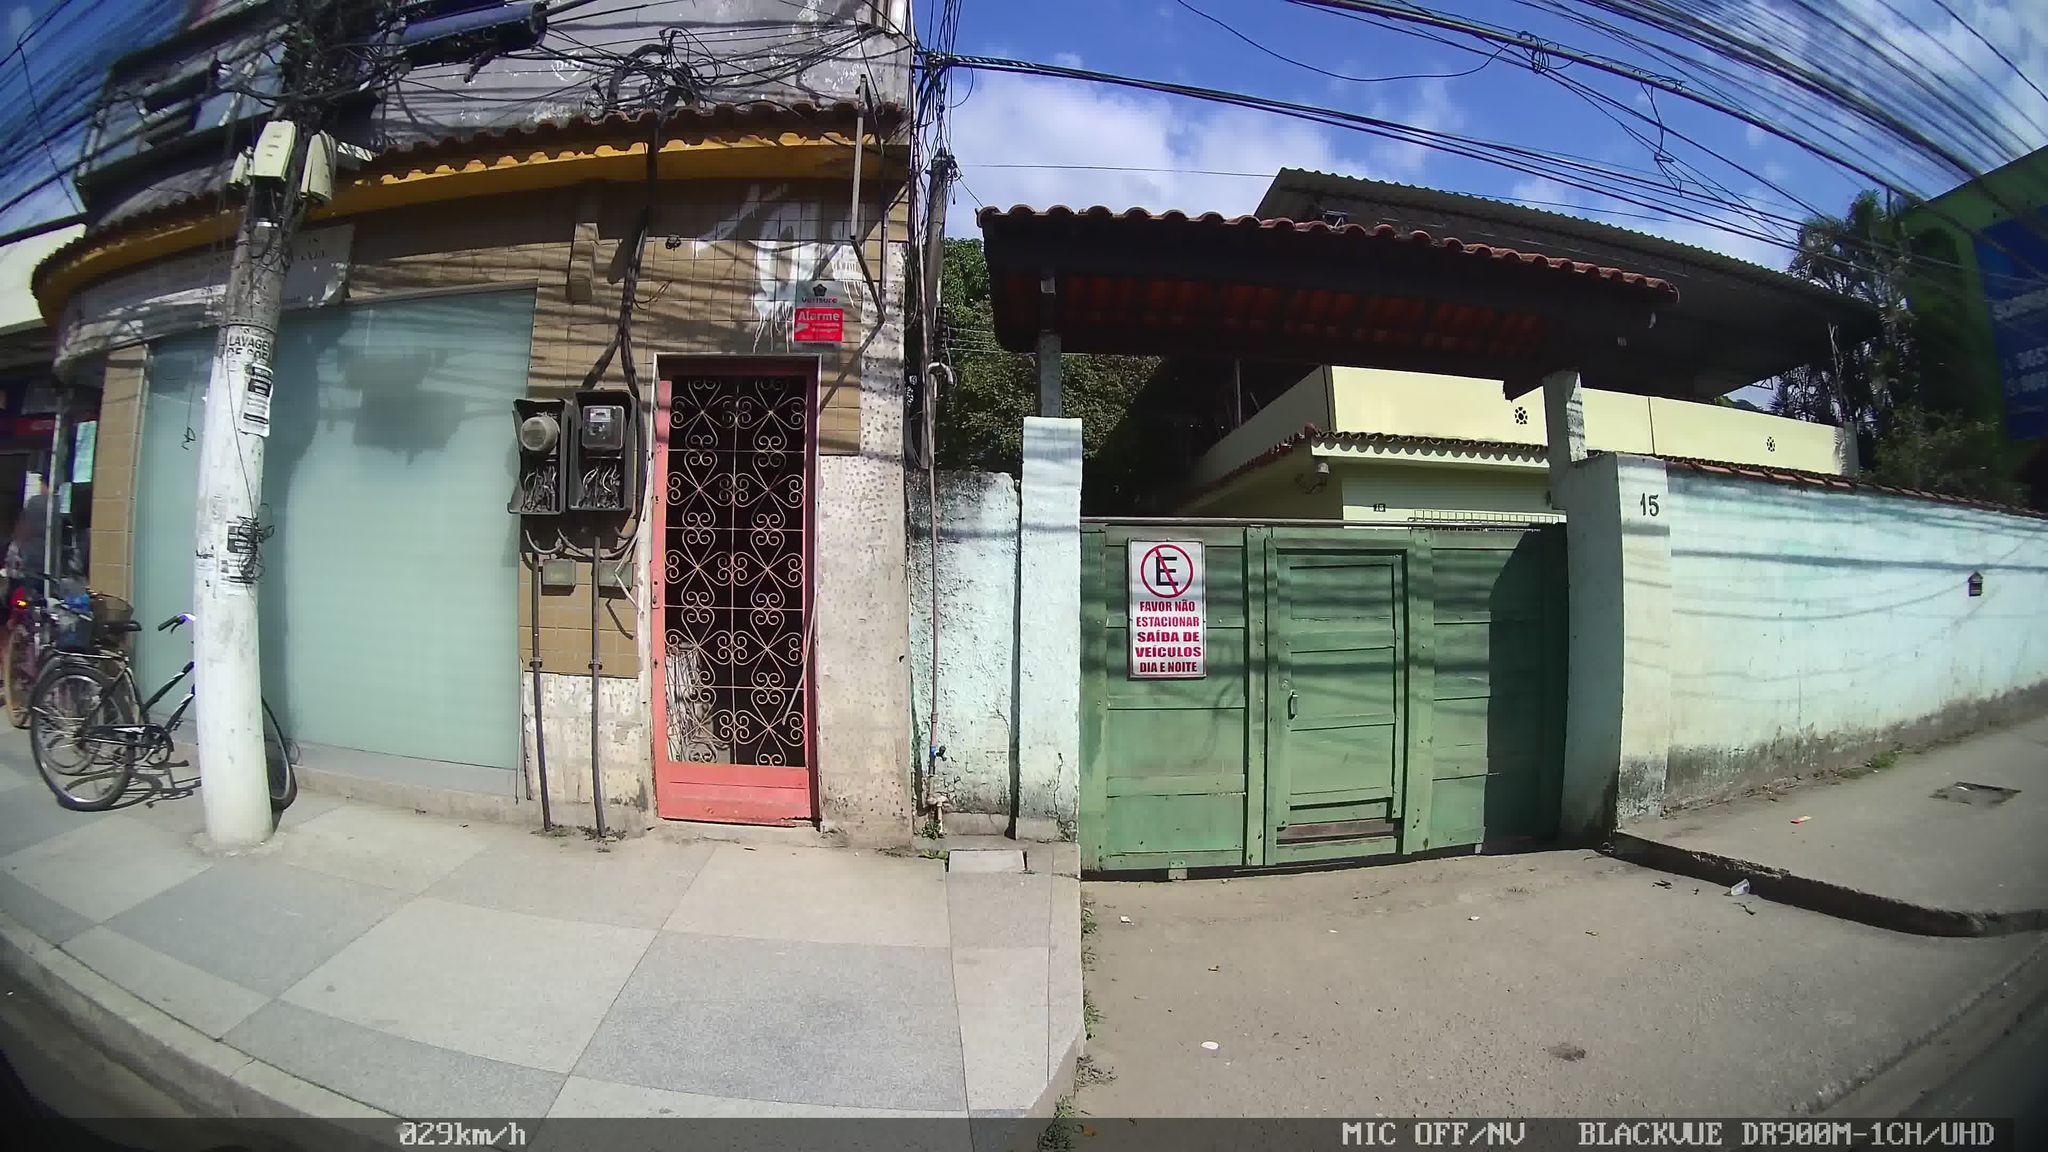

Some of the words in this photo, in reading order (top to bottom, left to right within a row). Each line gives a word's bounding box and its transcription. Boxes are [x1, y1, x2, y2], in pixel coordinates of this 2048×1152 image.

[798, 311, 840, 321] Alarme
[1640, 492, 1660, 517] 15
[1140, 601, 1172, 612] FAVOR
[1175, 599, 1195, 612] NÃO
[1136, 616, 1200, 628] ESTACIONAR
[1137, 630, 1180, 643] SAÍDA
[1183, 631, 1200, 643] DE
[1135, 645, 1202, 658] VEÍCULOS
[1140, 662, 1158, 673] DIA
[1160, 662, 1165, 673] E
[1167, 661, 1197, 673] NOITE
